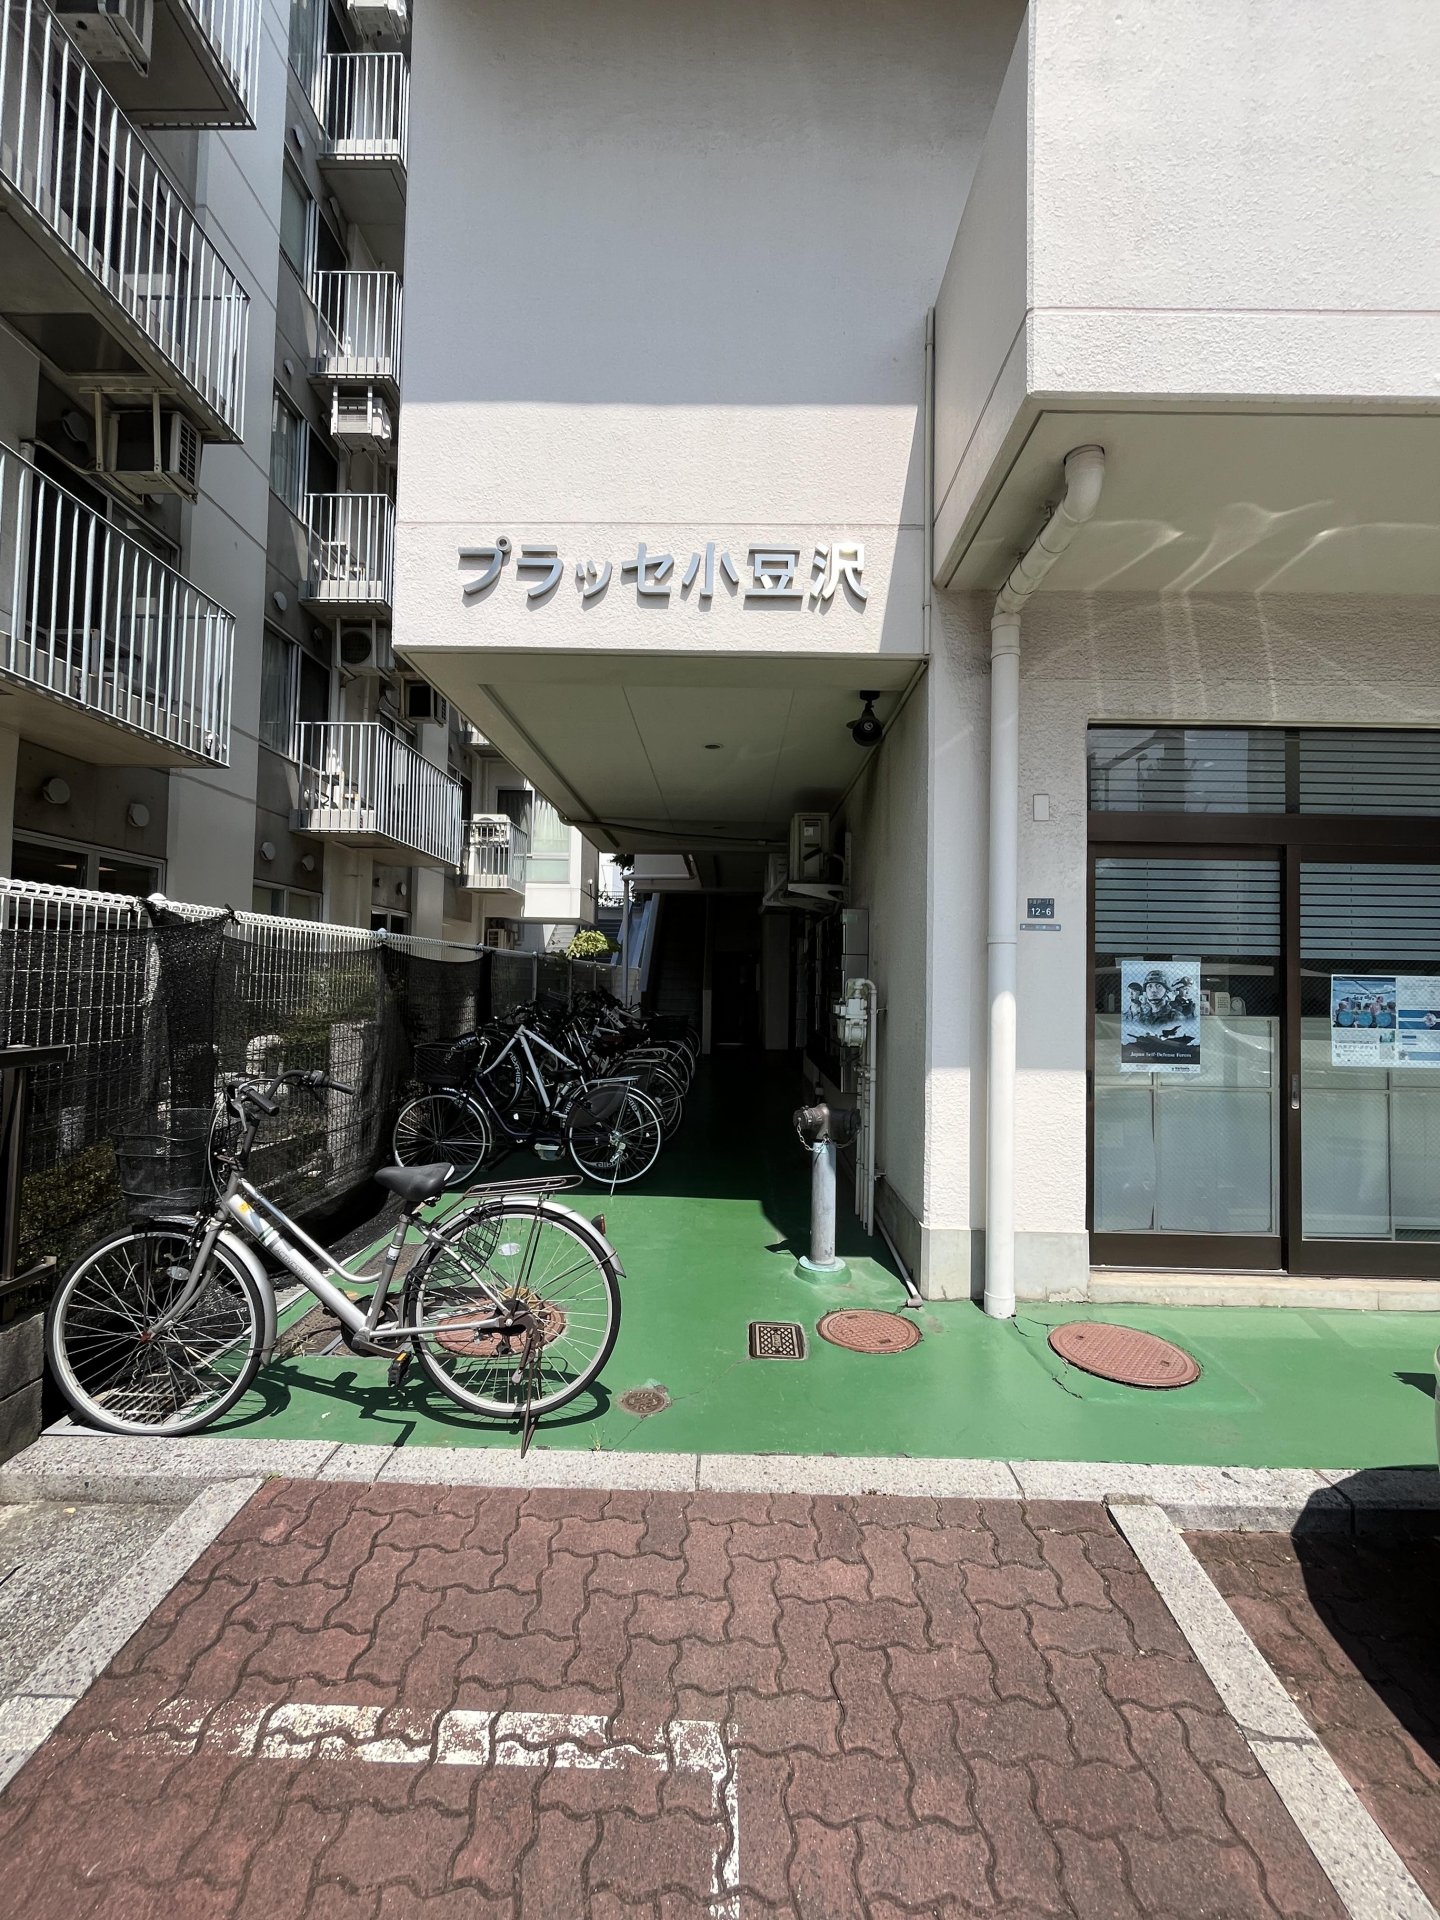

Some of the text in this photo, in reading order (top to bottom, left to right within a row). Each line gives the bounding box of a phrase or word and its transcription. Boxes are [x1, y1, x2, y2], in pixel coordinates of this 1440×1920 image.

[457, 535, 868, 600] プラッセ小豆沢
[1031, 907, 1052, 916] 12-6
